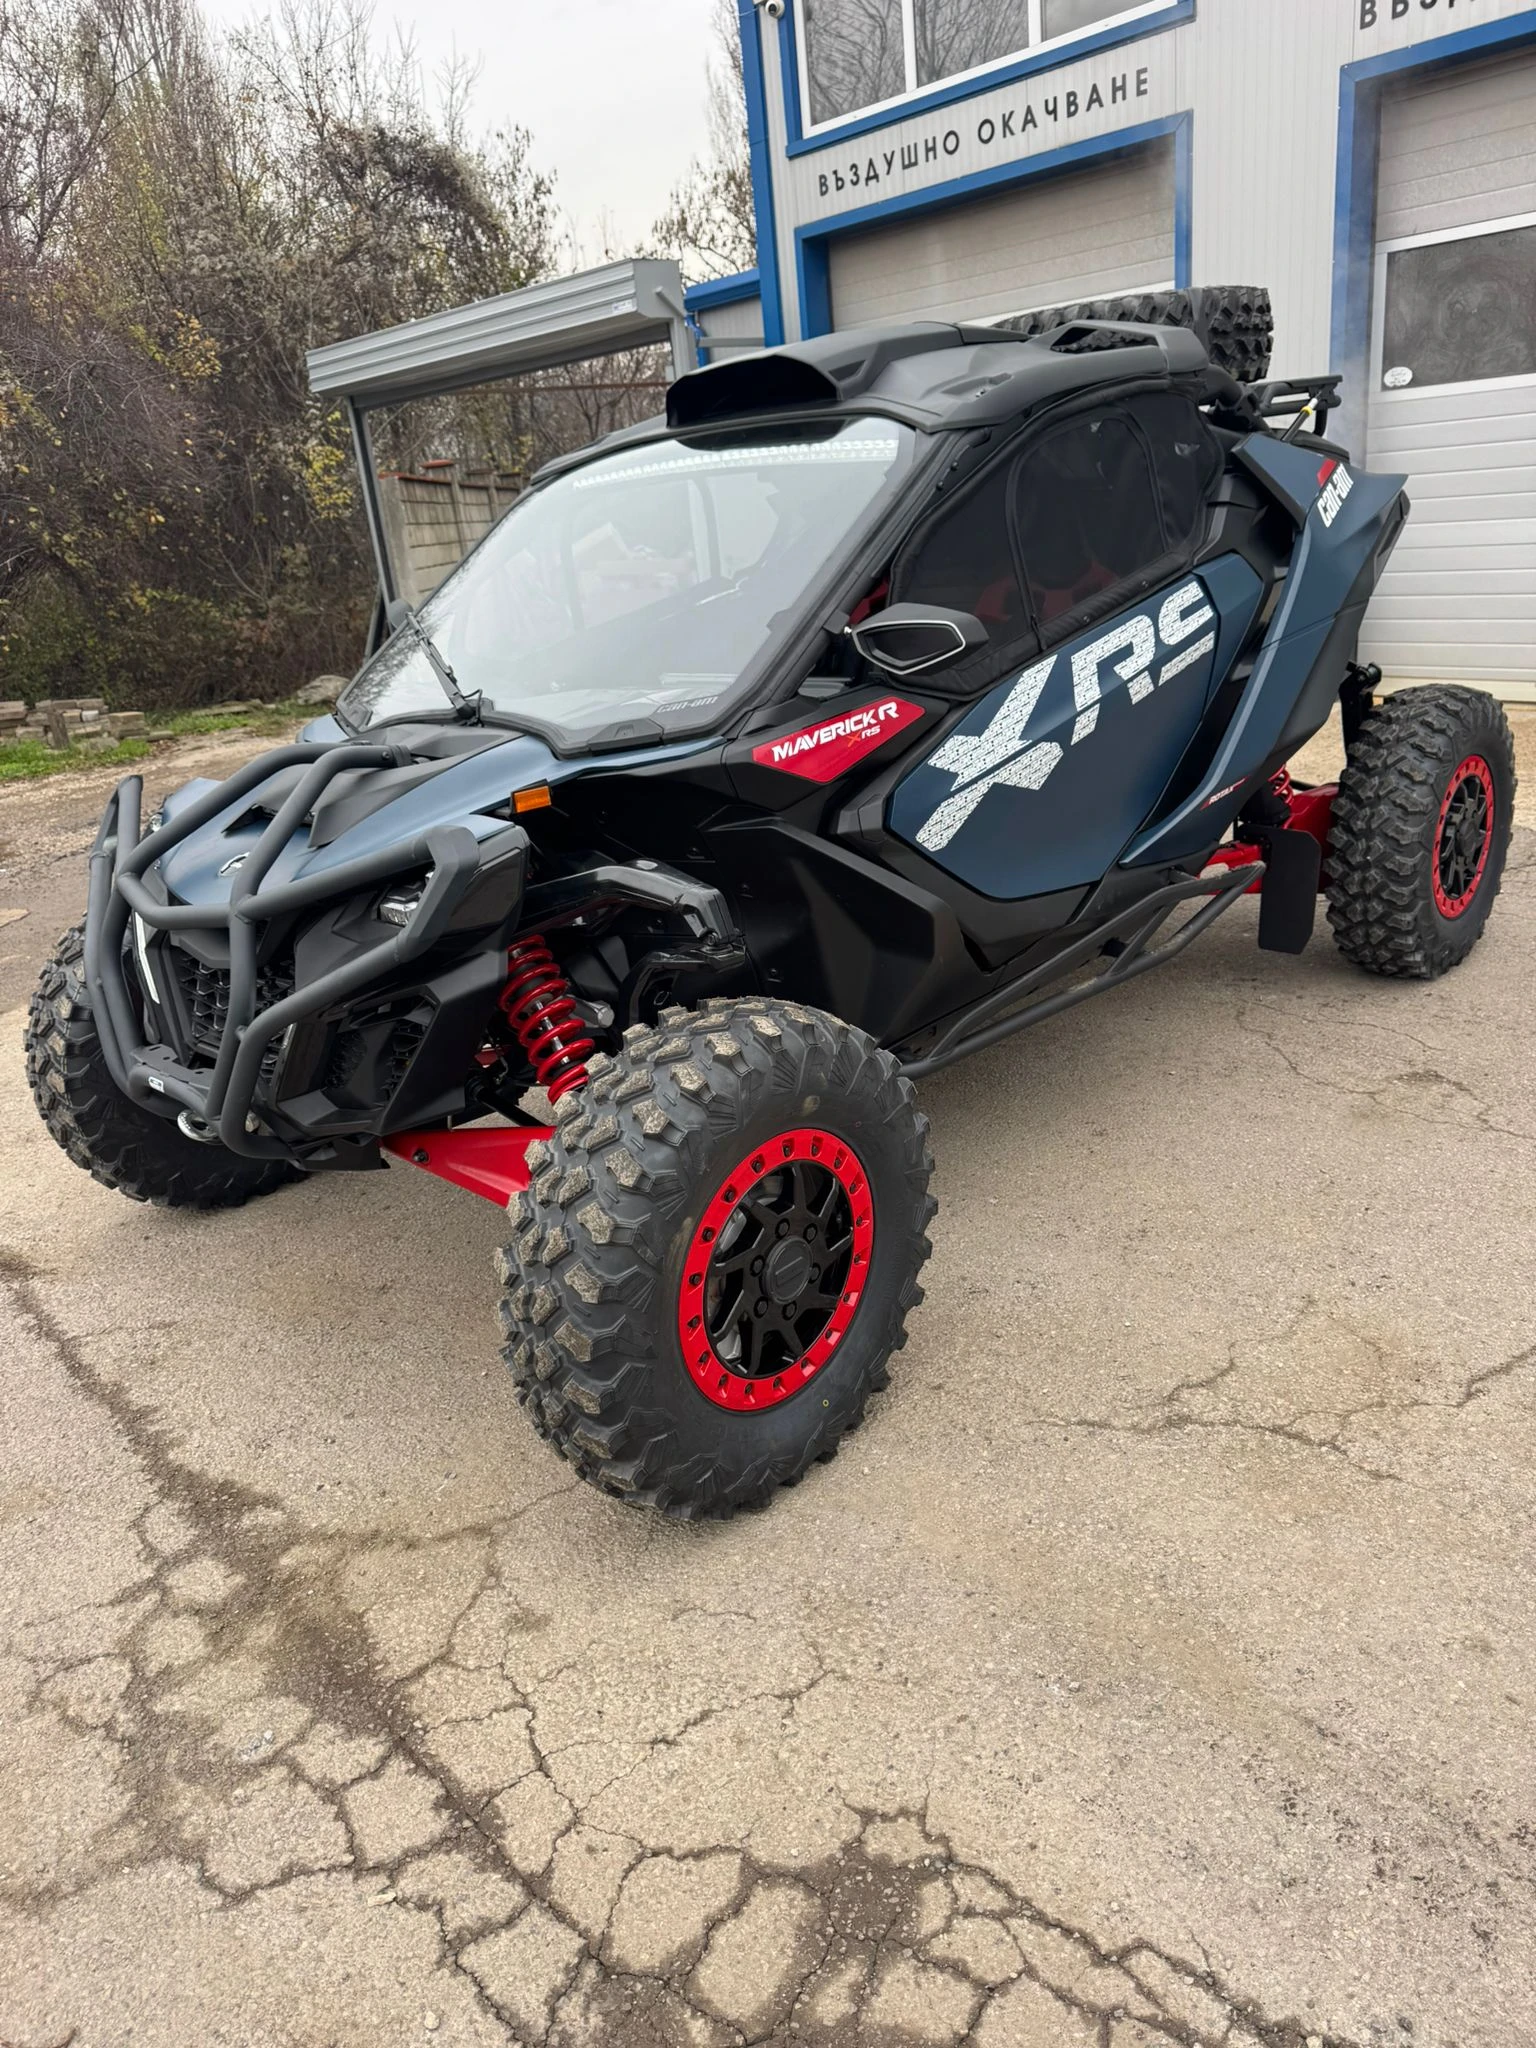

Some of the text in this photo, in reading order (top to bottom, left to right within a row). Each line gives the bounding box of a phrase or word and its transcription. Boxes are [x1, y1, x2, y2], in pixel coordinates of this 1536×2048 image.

[818, 67, 1149, 197] ВЪЗДУШНО ОКАЧВАНЕ
[771, 701, 899, 762] MAVERICK R
